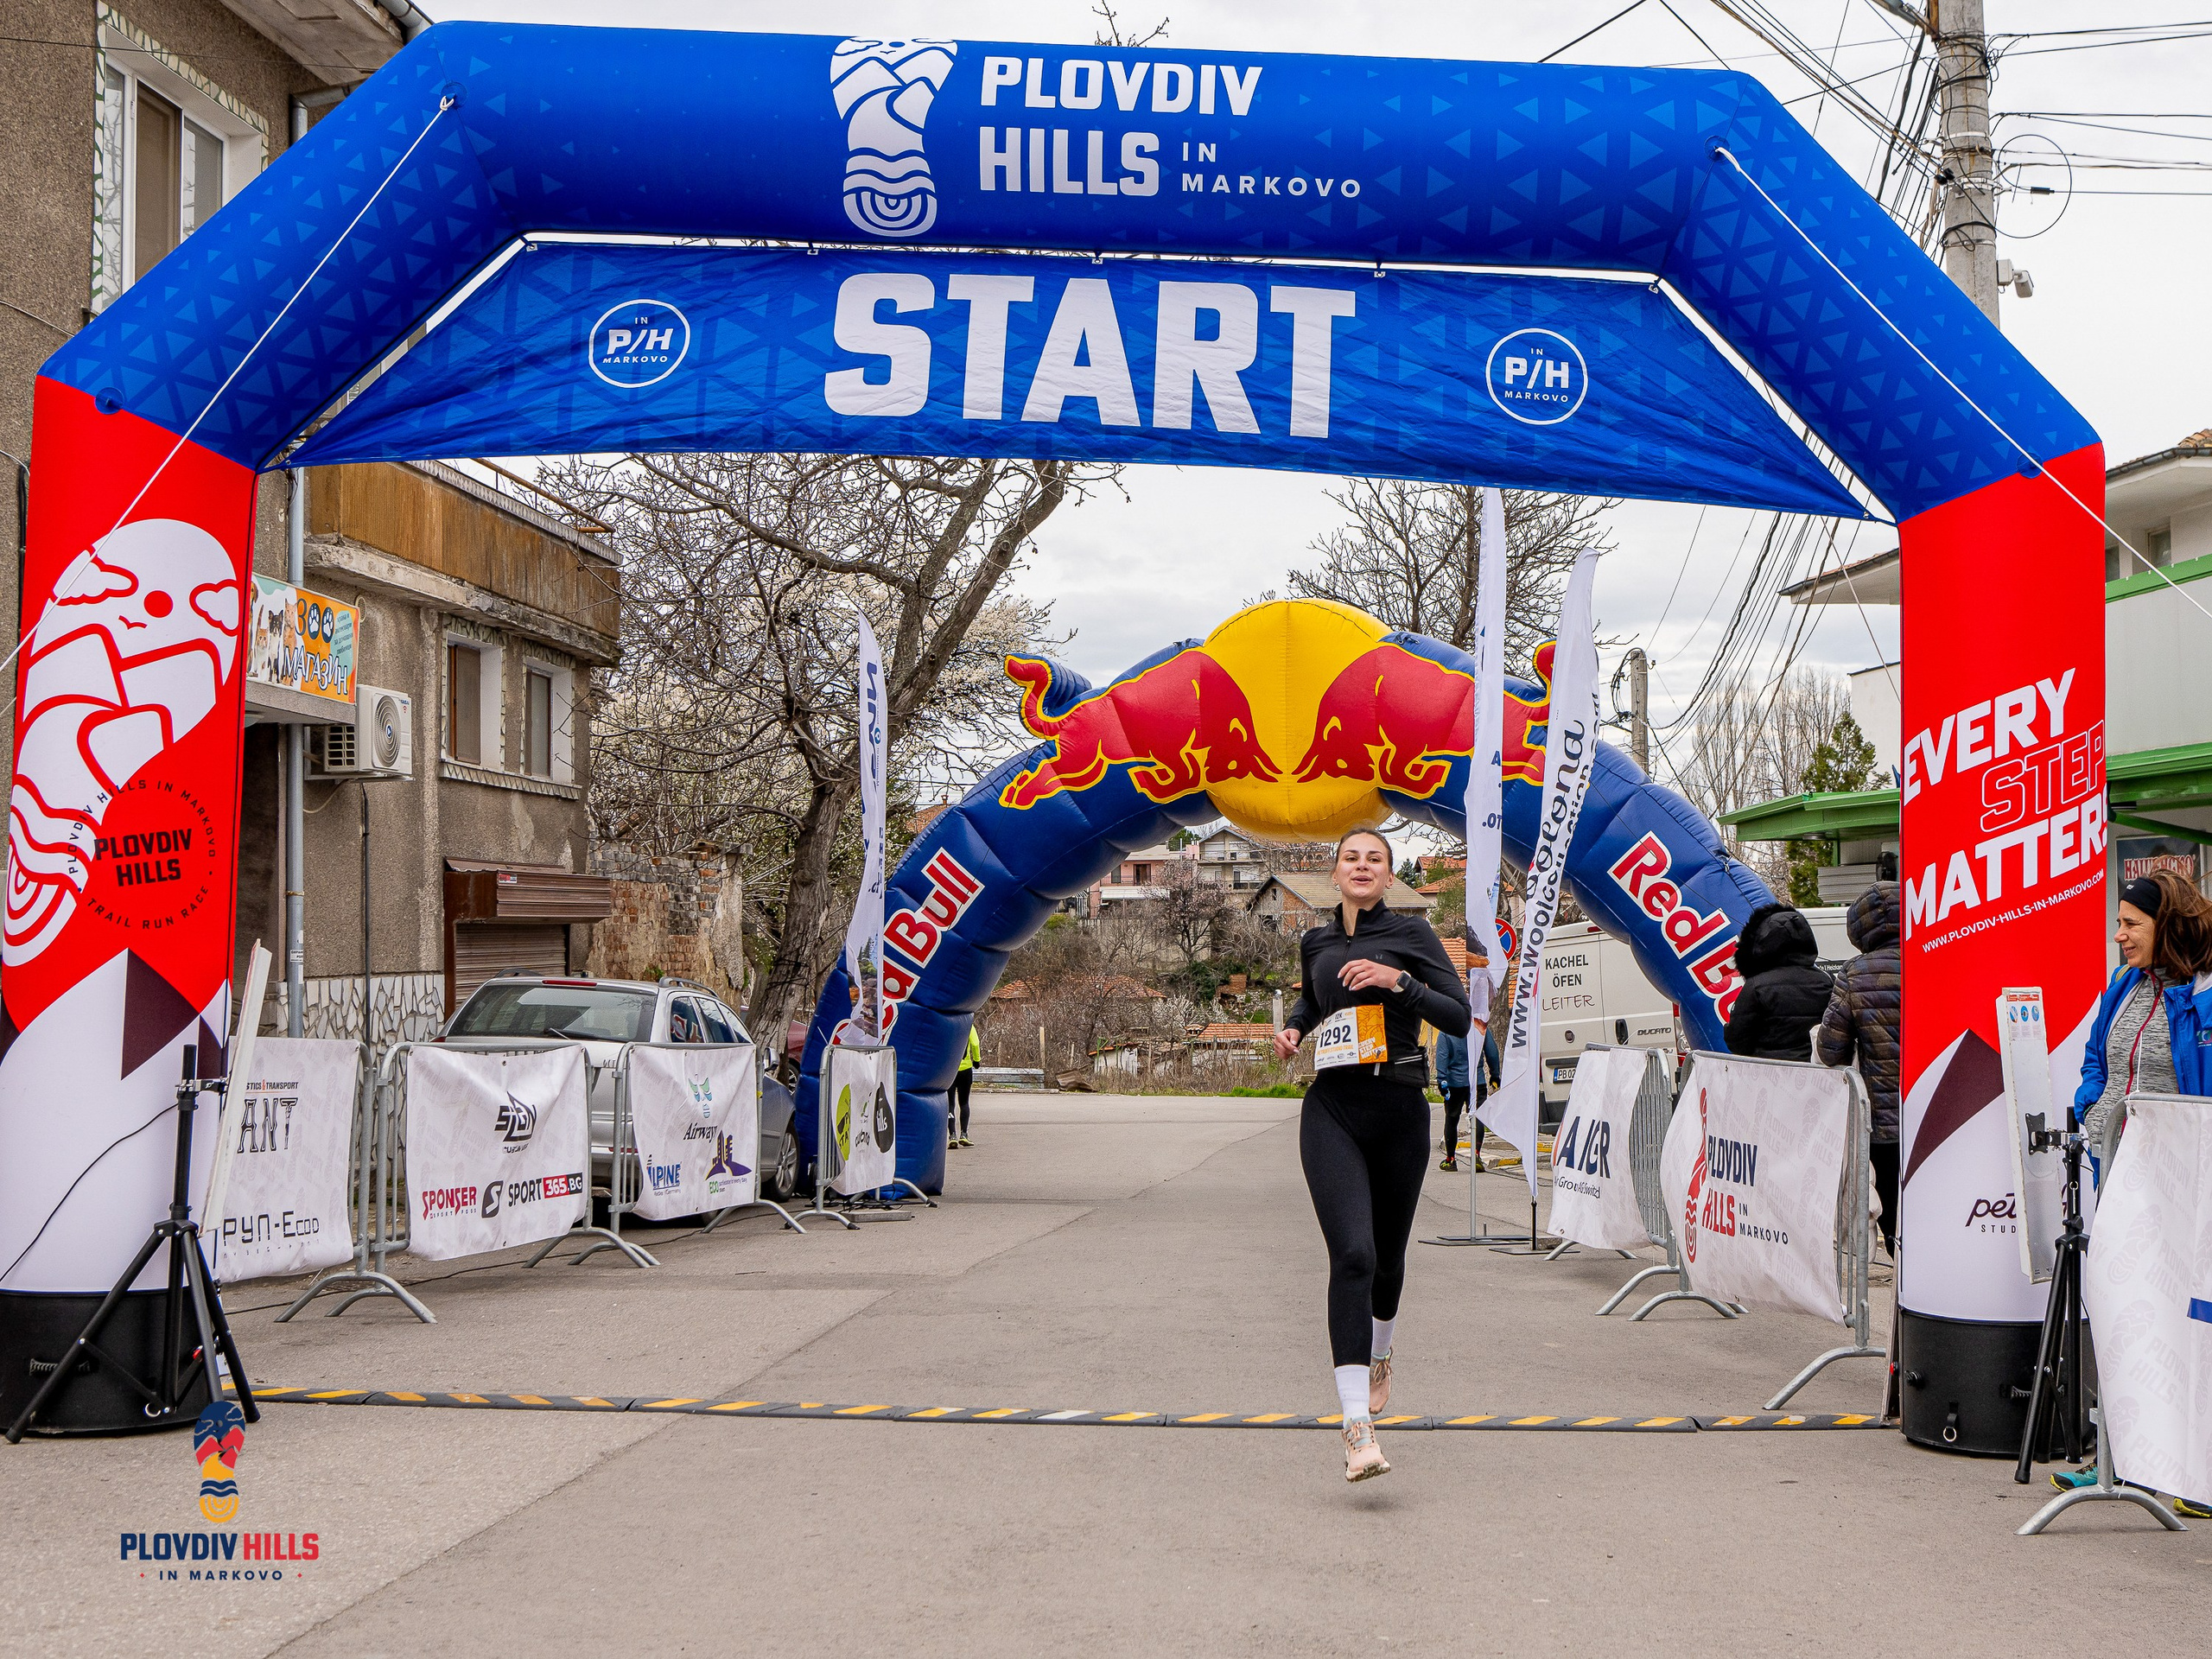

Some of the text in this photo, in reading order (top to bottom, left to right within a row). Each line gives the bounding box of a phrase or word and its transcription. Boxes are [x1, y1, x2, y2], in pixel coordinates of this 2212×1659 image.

[980, 55, 1262, 116] PLOVDIV
[980, 126, 1160, 196] HILLS
[1183, 142, 1217, 162] IN
[1182, 173, 1362, 198] MARKOVO
[634, 316, 648, 325] IN
[607, 328, 674, 355] P/H
[823, 273, 1356, 438] START
[602, 355, 668, 364] MARKOVO
[1504, 356, 1569, 389] P/H
[1504, 390, 1568, 403] MARKOVO
[283, 645, 347, 695] МАГАЗИН
[1904, 667, 2075, 807] EVERY
[1980, 719, 2105, 833] STEP
[67, 779, 216, 874] PLOVDIV HILLS IN MARKOVO
[94, 828, 193, 861] PLOVDIV
[116, 858, 181, 887] HILLS
[87, 886, 209, 930] TRAIL RUN RACE
[883, 847, 985, 969] Bull
[1607, 830, 1731, 960] Red
[1923, 868, 2105, 953] WWW.PLOVDIV-HILLS-IN-MARKOVO.COM
[1545, 955, 1589, 970] KACHEL
[1552, 974, 1582, 988] ÖFEN
[1542, 995, 1595, 1011] LEITER
[1319, 1024, 1351, 1048] 1292
[1637, 1027, 1672, 1036] DUCATO
[1558, 1070, 1567, 1080] PB
[1708, 1135, 1758, 1187] PLOVDIV
[422, 1185, 477, 1220] SPONSER
[1738, 1203, 1748, 1217] IN
[1739, 1222, 1789, 1245] MARKOVO
